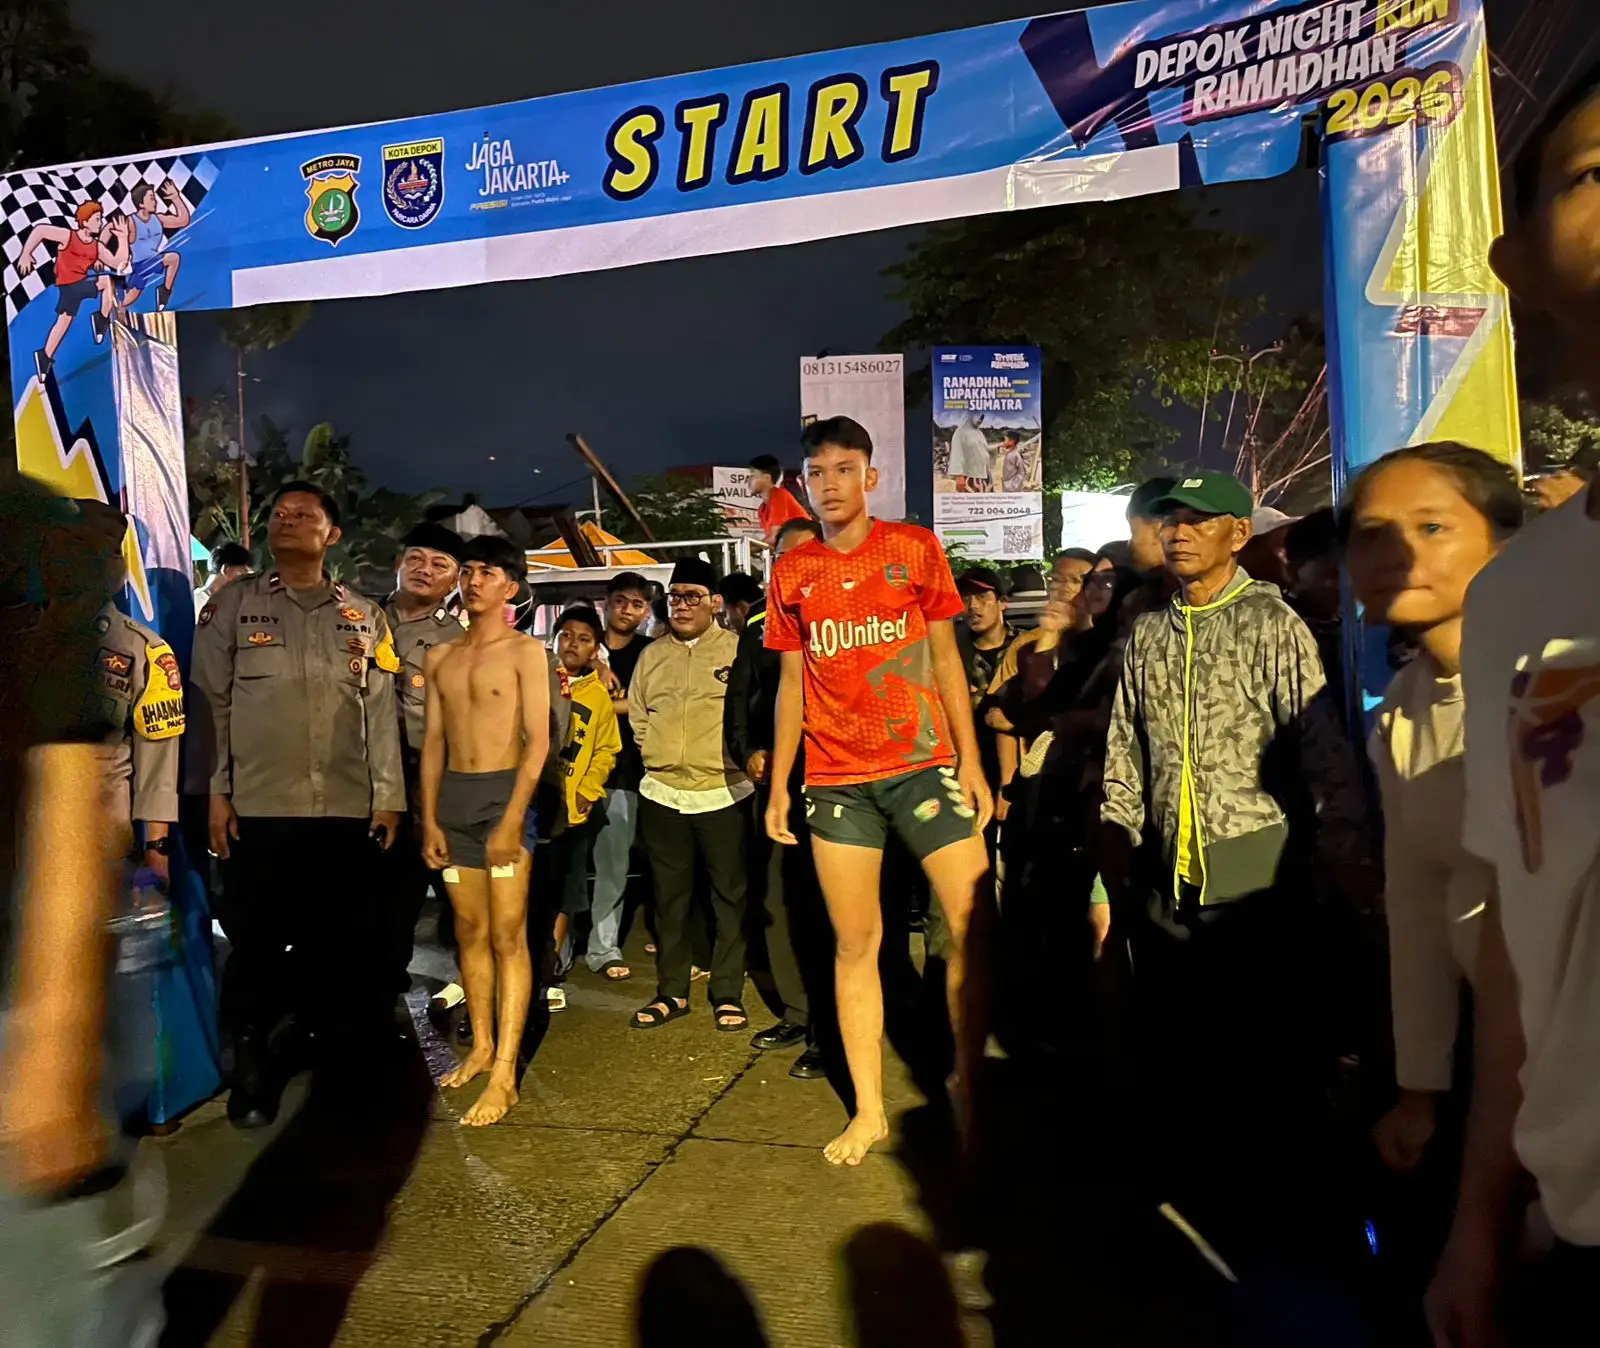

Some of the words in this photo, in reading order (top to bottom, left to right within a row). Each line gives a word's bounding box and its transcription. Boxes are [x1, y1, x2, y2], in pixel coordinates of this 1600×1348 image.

[1134, 26, 1251, 89] DEPOK
[1256, 1, 1367, 61] NIGHT
[1192, 34, 1398, 116] RAMADHAN
[1325, 70, 1453, 134] 2026
[606, 65, 935, 197] START
[388, 147, 409, 158] KOTA
[410, 143, 438, 155] DEPOK
[465, 138, 514, 171] JAGA
[306, 159, 334, 173] METRO
[335, 158, 355, 168] JAYA
[803, 360, 901, 375] 081315486027
[943, 376, 1012, 388] RAMADHAN,
[943, 388, 996, 400] LUPAKAN
[969, 399, 1023, 411] SUMATRA
[967, 507, 985, 515] 722
[240, 616, 280, 625] EDDY
[336, 624, 371, 634] POLRI
